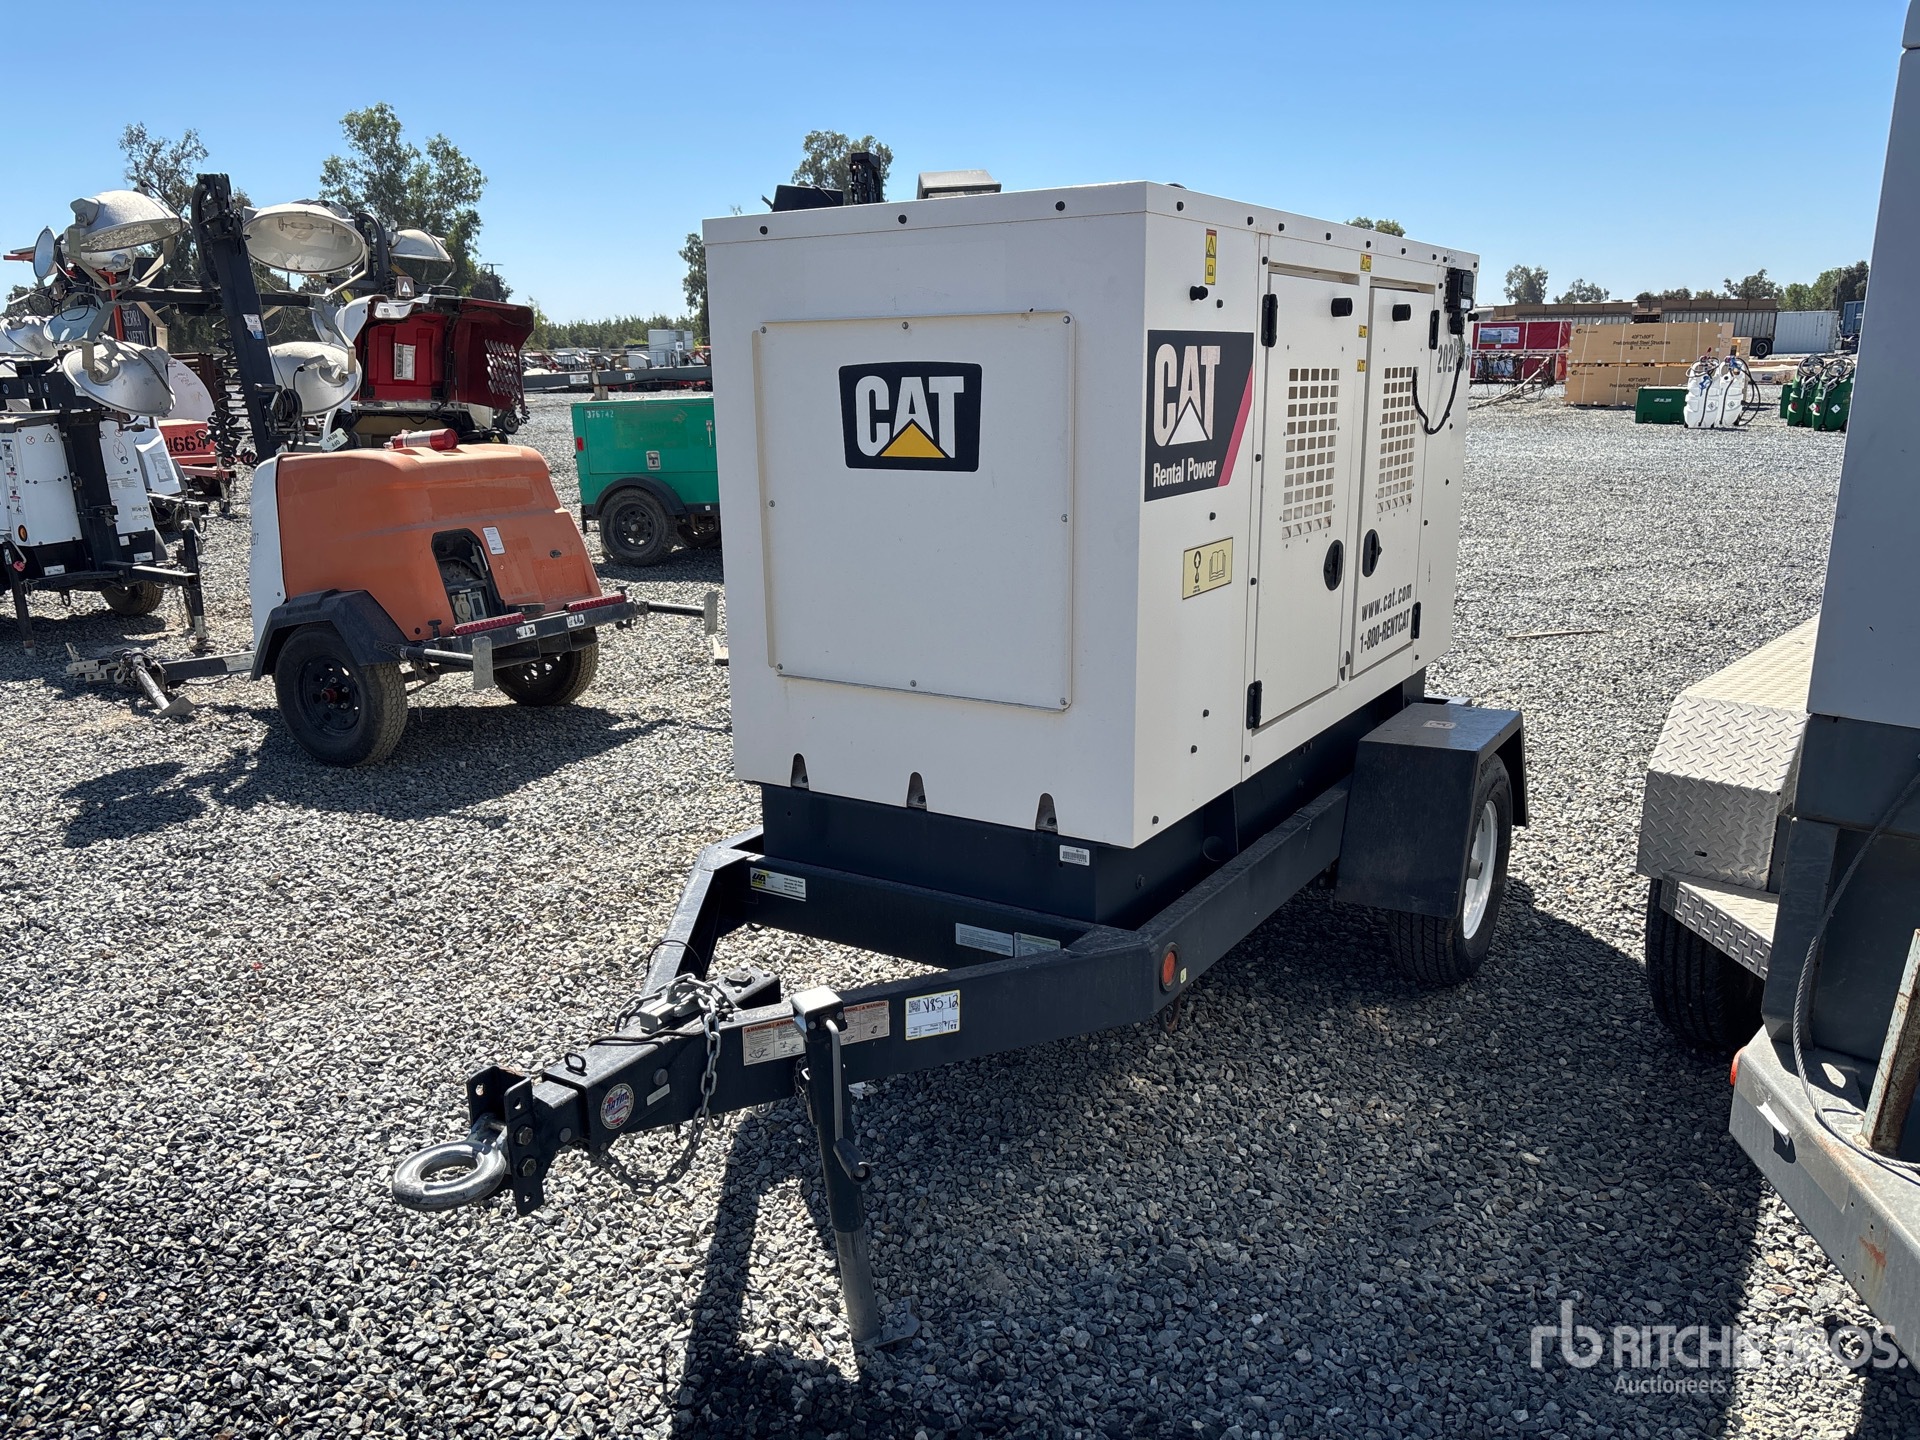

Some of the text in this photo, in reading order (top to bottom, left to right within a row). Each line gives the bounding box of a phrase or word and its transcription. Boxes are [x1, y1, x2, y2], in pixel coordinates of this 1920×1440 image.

[855, 375, 965, 459] CAT
[1153, 343, 1221, 447] CAT
[1153, 457, 1217, 488] Rental Power
[1361, 583, 1412, 622] www.cat.com
[1360, 607, 1411, 654] 1-800-RENTCAT
